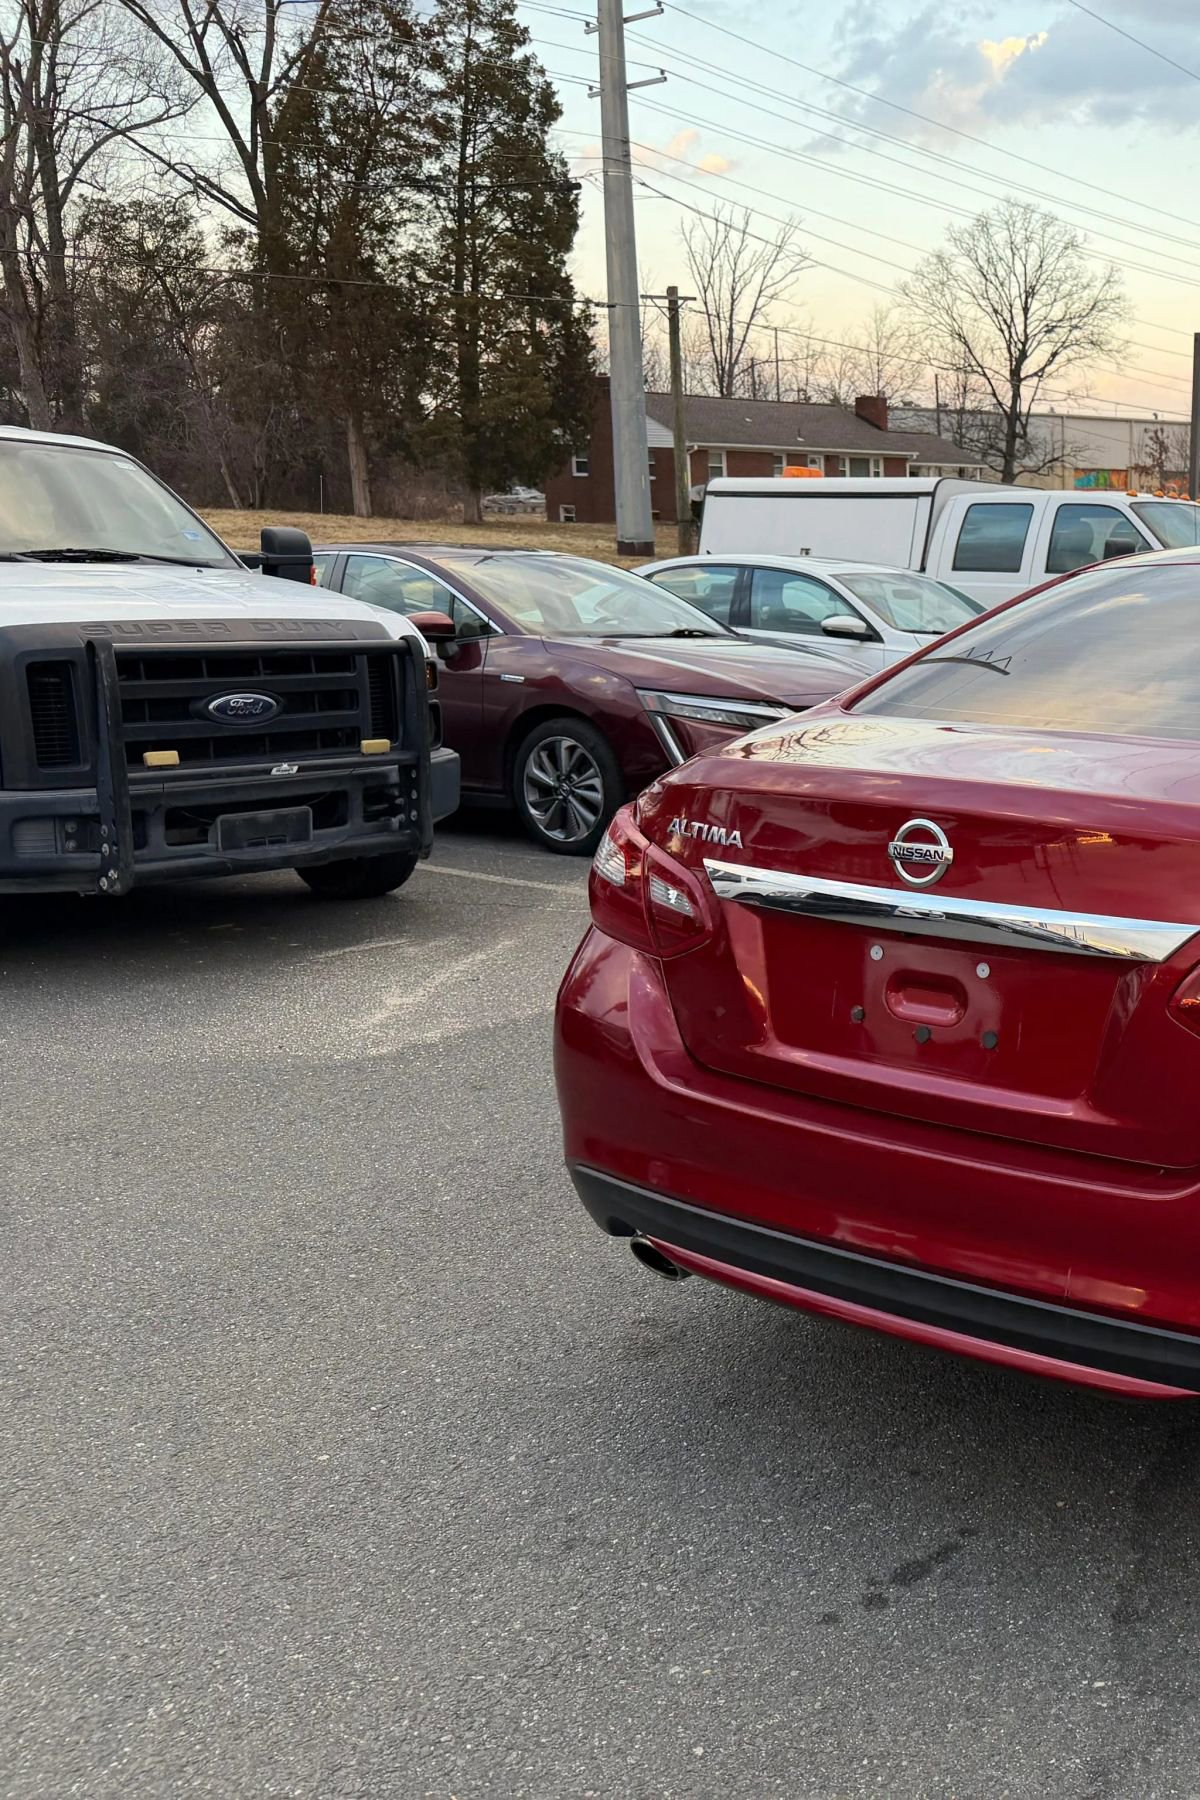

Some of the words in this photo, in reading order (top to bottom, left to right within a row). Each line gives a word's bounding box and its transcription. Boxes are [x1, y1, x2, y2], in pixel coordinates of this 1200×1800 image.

[80, 622, 232, 638] SUPER
[249, 621, 344, 633] DUTY
[226, 698, 264, 716] Ford
[667, 817, 744, 849] ALTIMA
[892, 844, 945, 861] NISSAN
